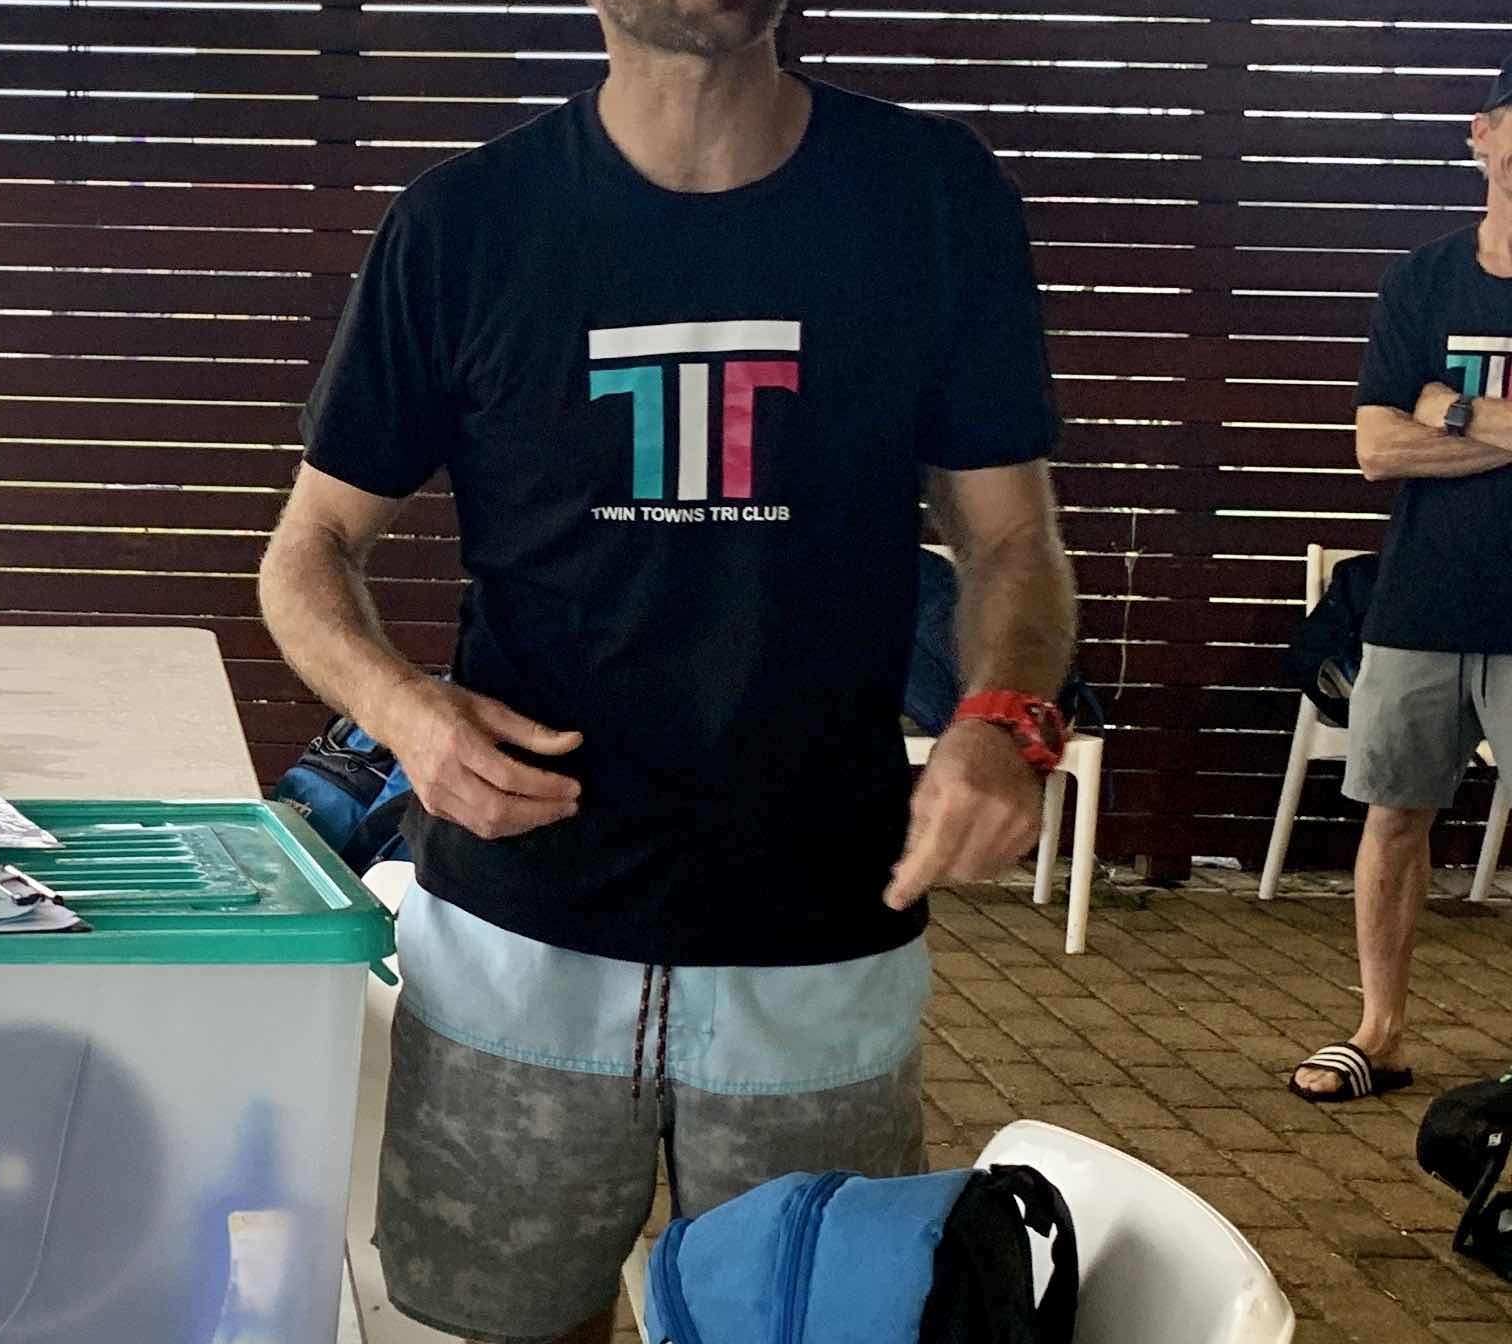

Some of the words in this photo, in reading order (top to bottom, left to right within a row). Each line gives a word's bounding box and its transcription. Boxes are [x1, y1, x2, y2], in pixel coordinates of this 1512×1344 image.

[590, 505, 637, 522] TWIN
[640, 506, 706, 523] TOWNS
[709, 506, 739, 522] TRI
[742, 505, 791, 522] CLUB
